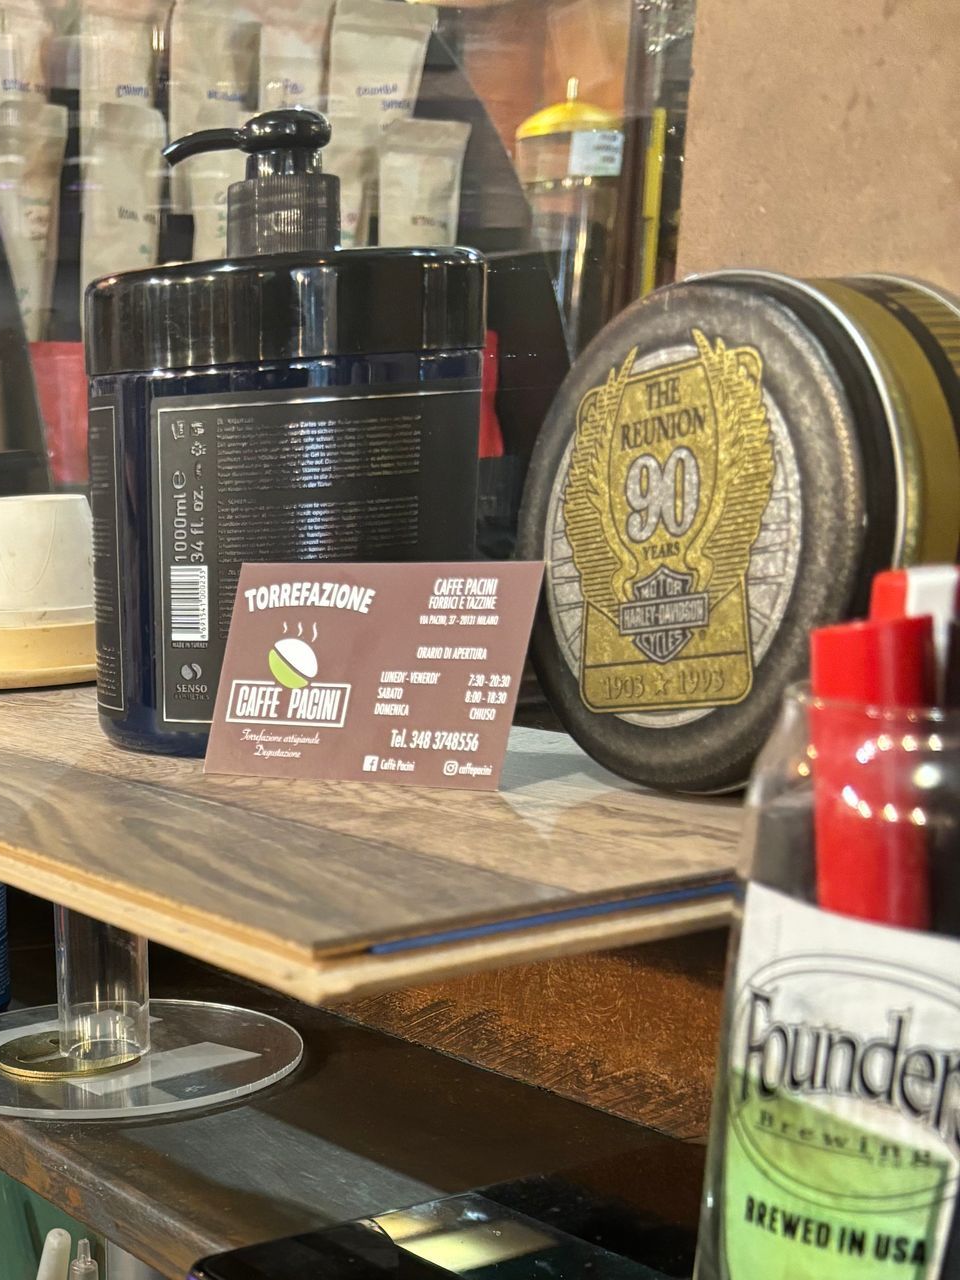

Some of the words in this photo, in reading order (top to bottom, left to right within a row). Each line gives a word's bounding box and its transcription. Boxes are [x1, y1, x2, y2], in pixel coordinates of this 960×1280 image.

[646, 377, 680, 411] THE
[620, 406, 706, 451] REUNION
[192, 486, 205, 511] oz.
[625, 446, 700, 543] 90
[173, 493, 188, 563] 1000ml
[189, 517, 205, 536] fl.
[189, 541, 205, 563] 34
[642, 541, 681, 561] YEARS
[434, 579, 464, 595] CAFFE
[465, 578, 498, 595] PACINI
[642, 578, 682, 599] MOTOR
[245, 583, 376, 614] TORREFAZIONE
[429, 596, 458, 609] FORBICI
[466, 597, 497, 609] TAZZINE
[623, 602, 705, 631] HARLEY-DAVIDSON
[642, 630, 683, 652] CYCLES
[417, 647, 444, 659] ORARIO
[444, 648, 452, 659] DI
[453, 647, 488, 660] APERTURA
[176, 684, 208, 693] SENSO
[468, 675, 485, 687] 7:30
[489, 675, 511, 688] 20:30
[605, 674, 645, 700] 1903
[679, 668, 725, 696] 1993
[236, 685, 283, 718] CAFFE
[287, 688, 341, 721] PACINI
[377, 687, 403, 700] SABATO
[465, 691, 482, 704] 8:00
[487, 692, 508, 704] 18:30
[374, 703, 409, 716] DOMENICA
[469, 708, 497, 721] CHIUSO
[390, 729, 408, 748] Tel.
[410, 731, 432, 749] 348
[432, 732, 479, 751] 3748556
[742, 988, 960, 1130] Founder
[745, 1194, 832, 1249] BREWED
[840, 1226, 866, 1256] IN
[874, 1231, 928, 1267] USA
